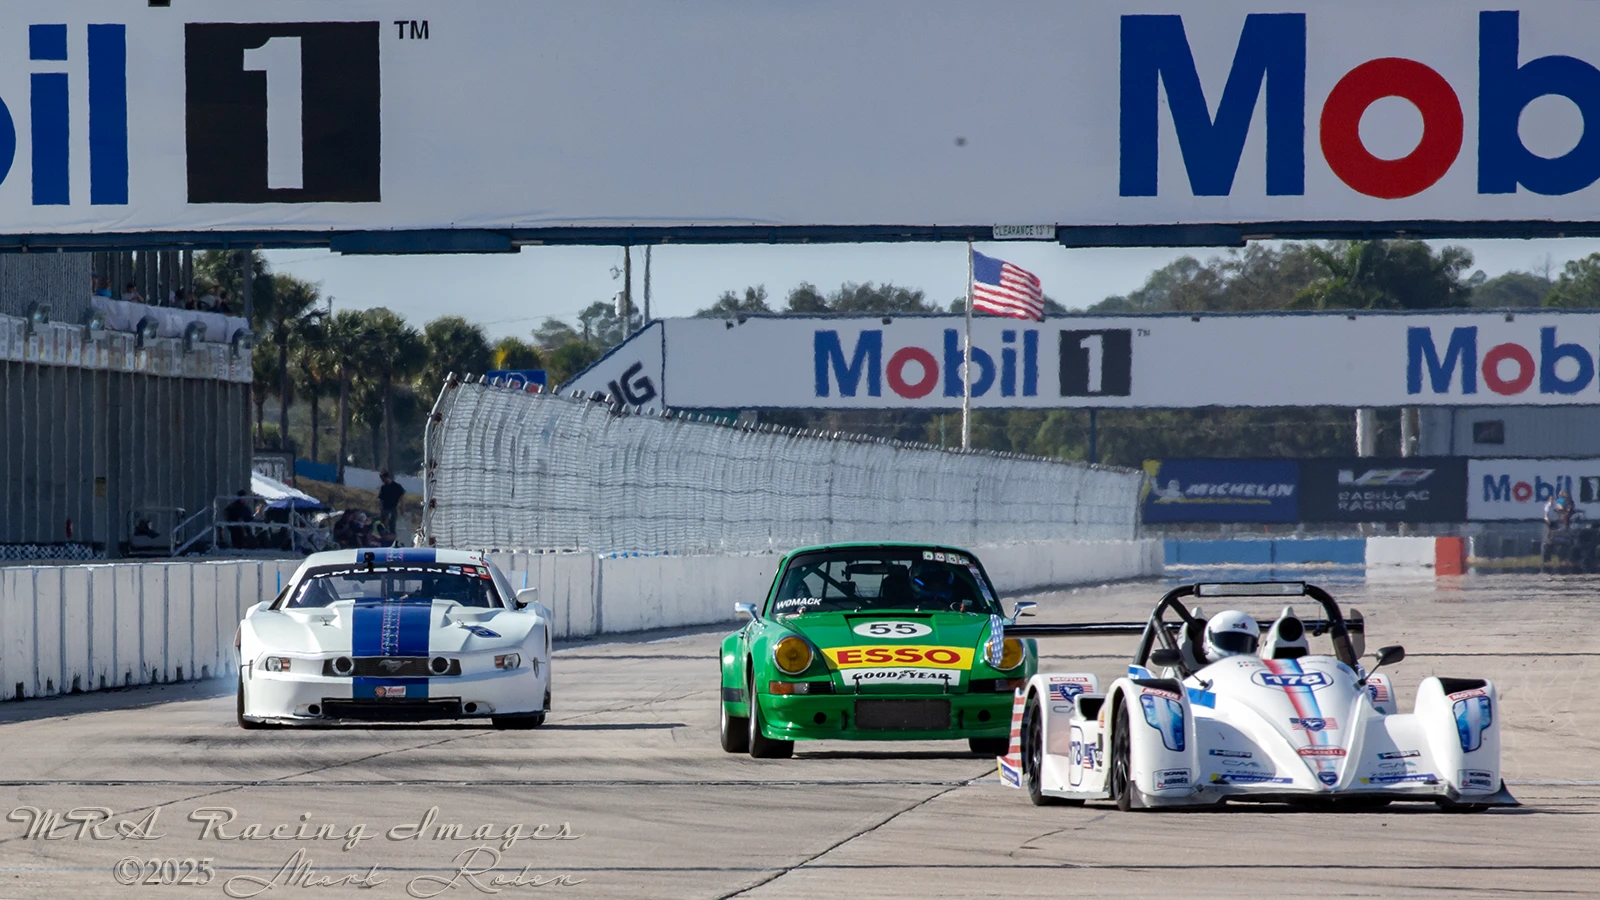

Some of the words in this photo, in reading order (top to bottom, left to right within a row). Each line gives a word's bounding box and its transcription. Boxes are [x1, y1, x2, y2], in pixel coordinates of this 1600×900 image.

[0, 24, 129, 206] il
[243, 36, 303, 190] 1
[394, 20, 430, 40] TM
[994, 225, 1034, 236] CLEARANCE
[814, 328, 1039, 400] Mobil
[1080, 334, 1103, 392] 1
[1136, 329, 1151, 338] TM
[1406, 326, 1600, 396] Mob
[1186, 483, 1295, 497] MICHELIN
[1338, 490, 1430, 500] CADILLAC
[1483, 474, 1572, 503] Mobil
[1338, 501, 1406, 511] RACING
[776, 597, 822, 610] WOMACK
[869, 623, 918, 635] 55
[837, 648, 961, 665] ESSO
[1265, 673, 1322, 686] 178
